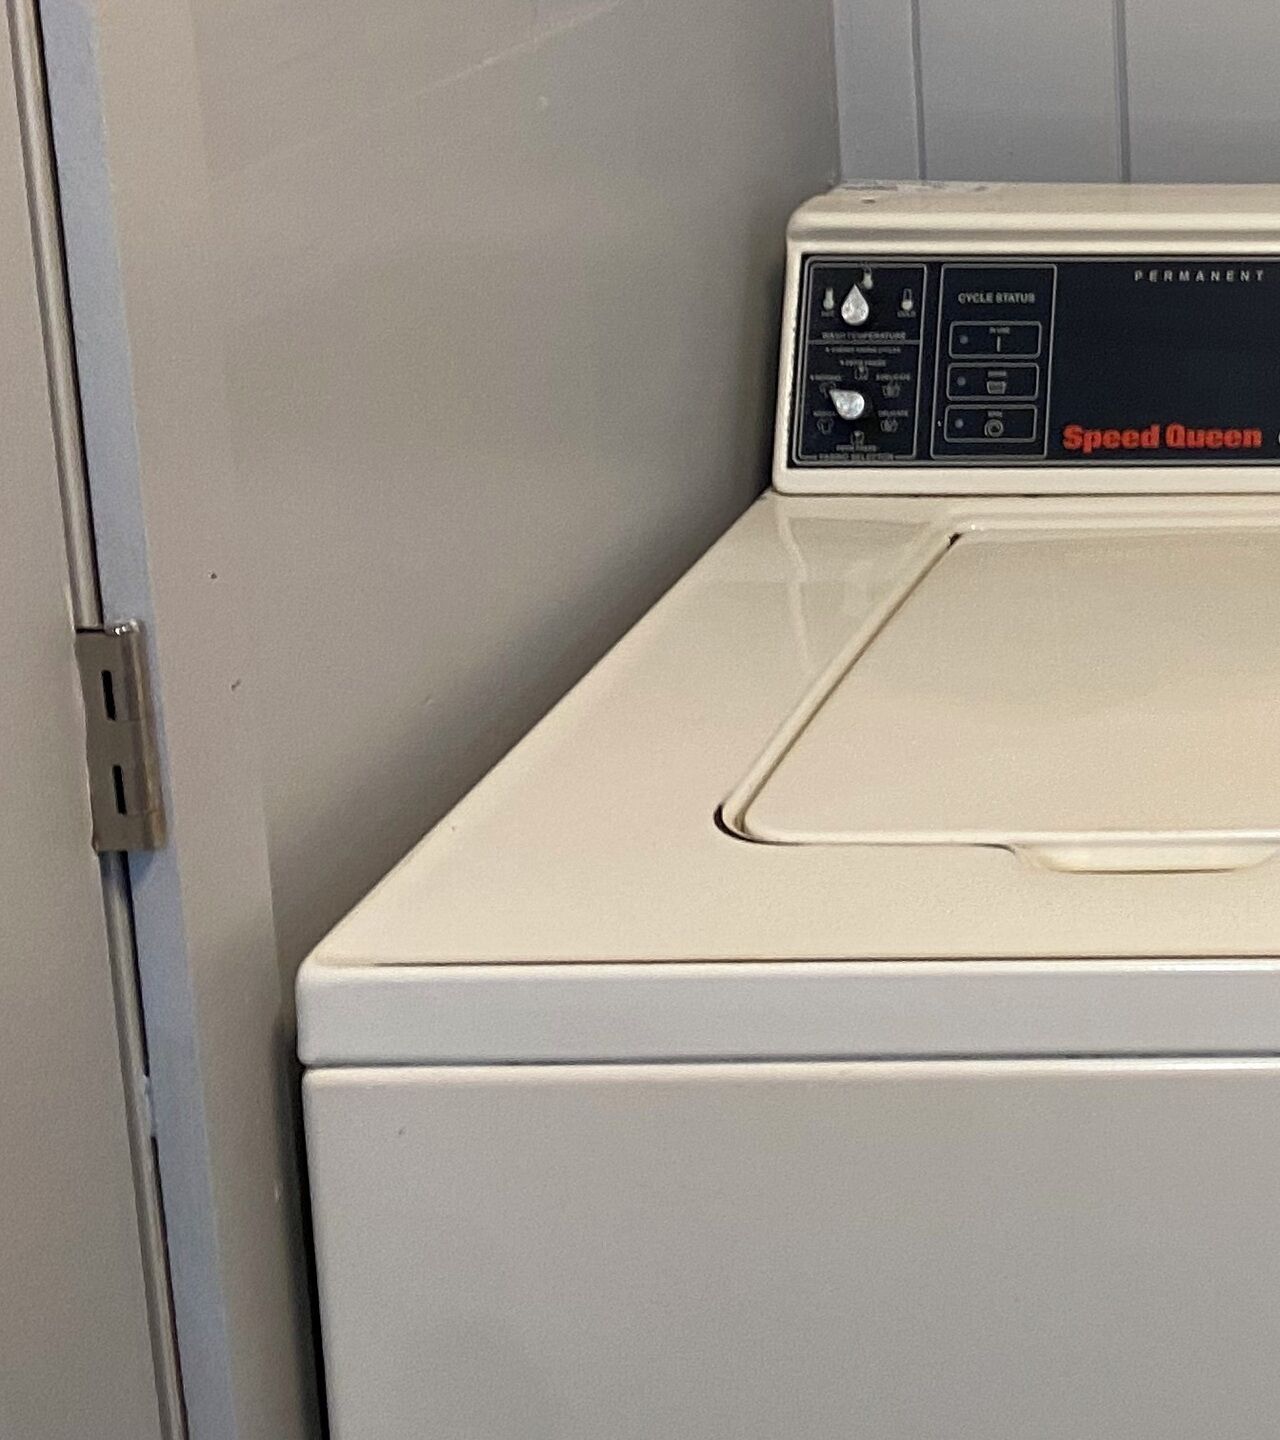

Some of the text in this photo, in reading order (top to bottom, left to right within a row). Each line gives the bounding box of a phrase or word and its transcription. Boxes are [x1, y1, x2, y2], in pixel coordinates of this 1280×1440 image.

[1134, 270, 1266, 283] PERMANENT
[957, 292, 1036, 304] CYCLE STATUS
[1062, 424, 1160, 454] Speed
[1165, 423, 1263, 450] Queen
